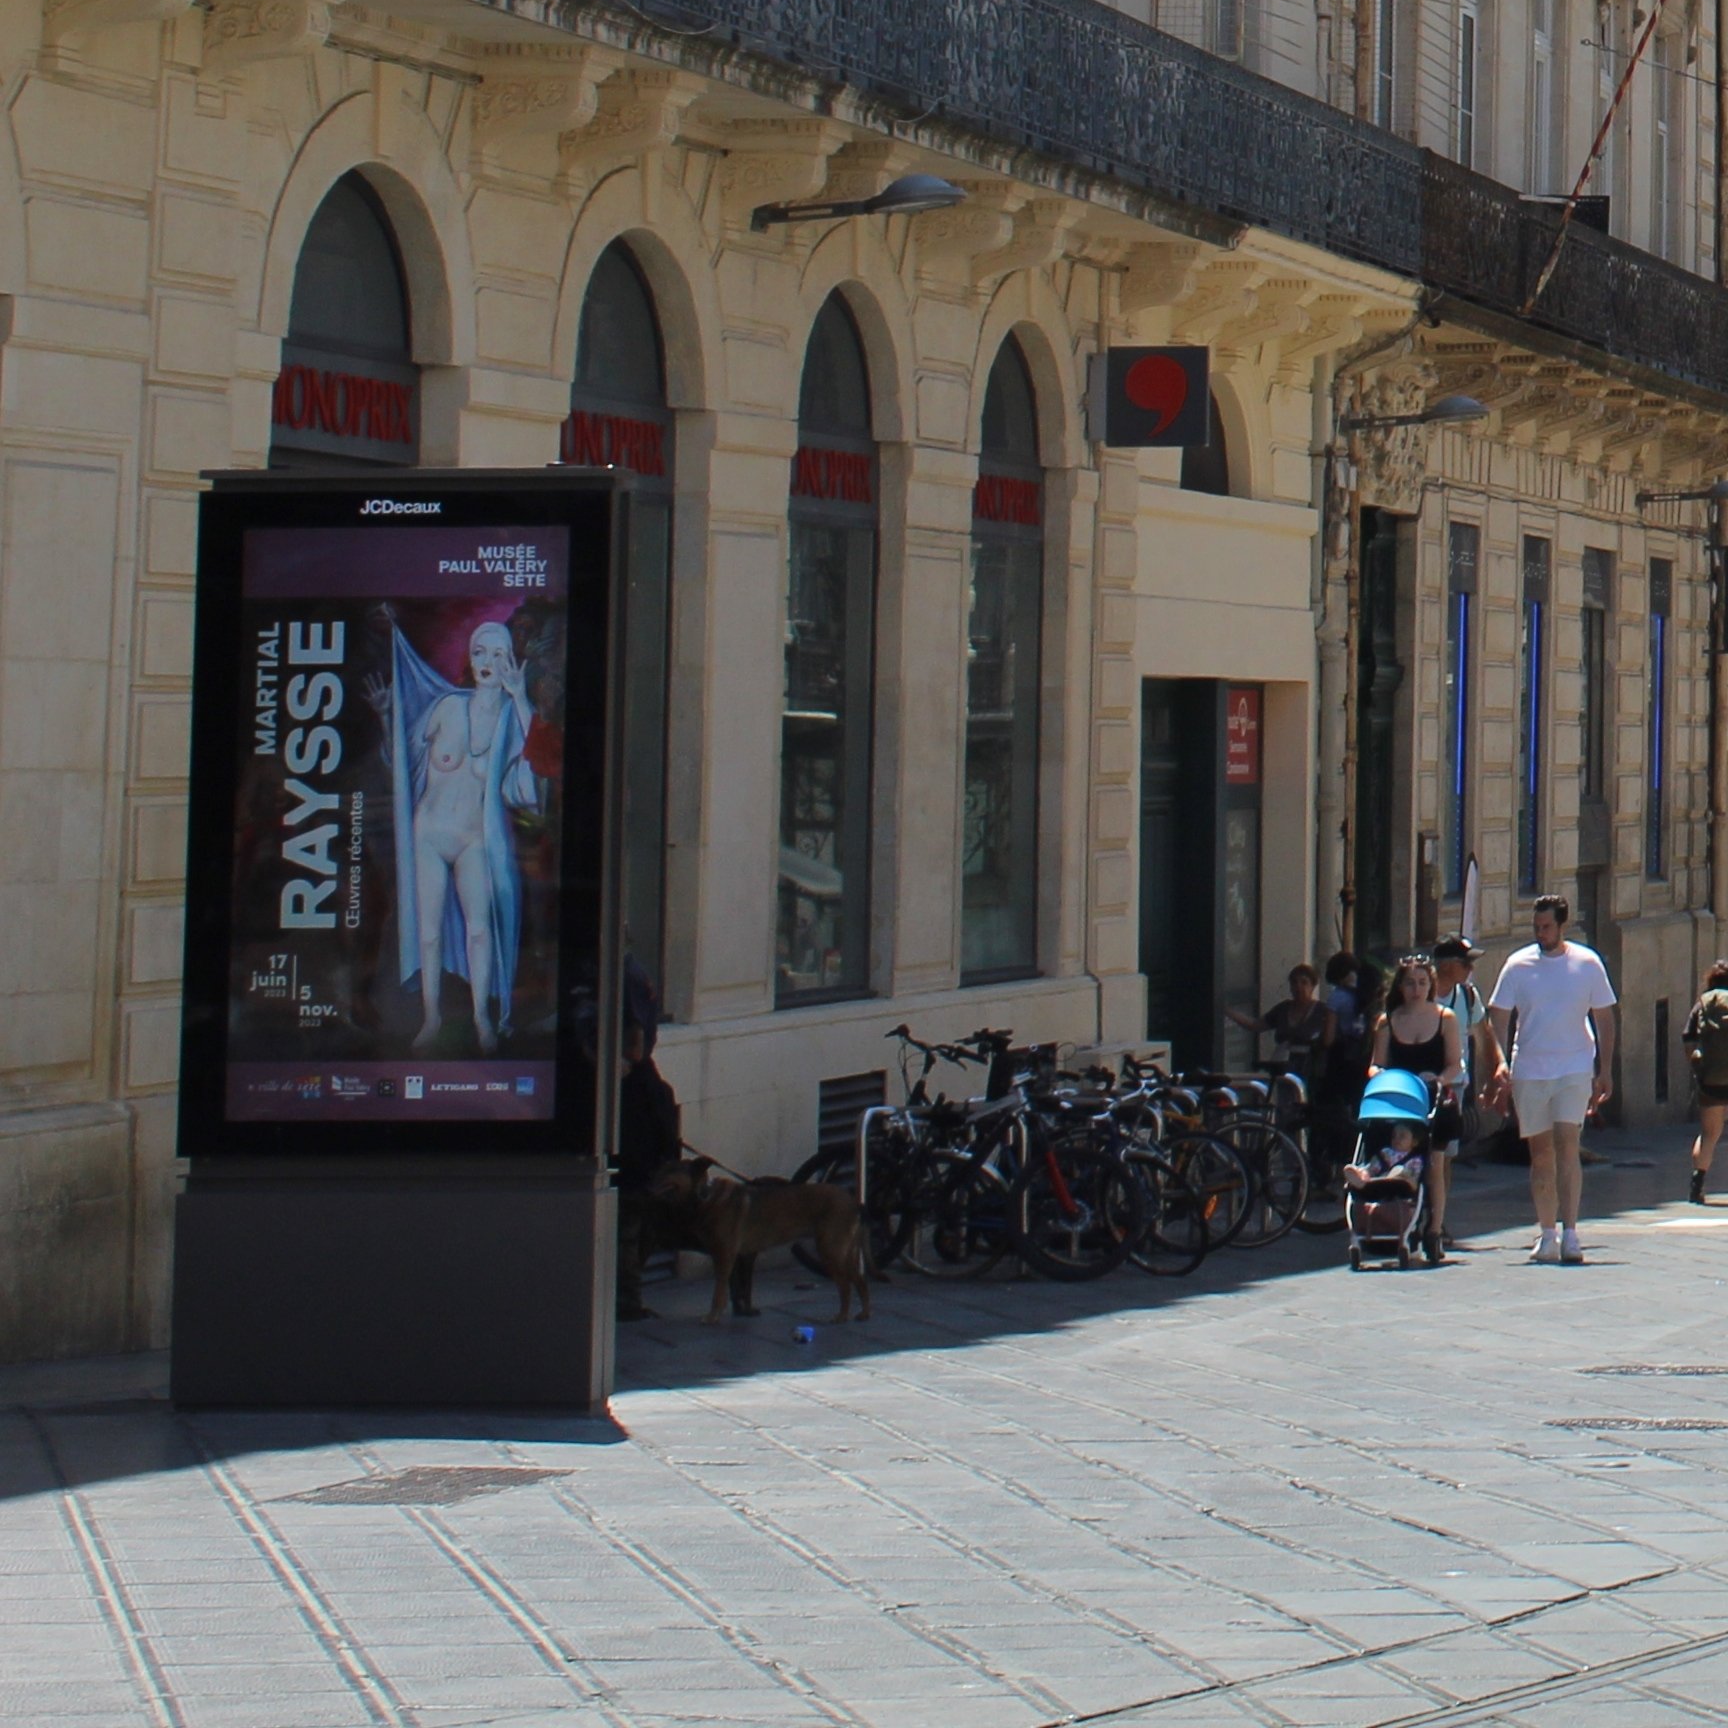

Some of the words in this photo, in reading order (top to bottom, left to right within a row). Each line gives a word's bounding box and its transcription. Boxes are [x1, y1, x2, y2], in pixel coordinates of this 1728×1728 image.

[359, 499, 441, 515] JCDecaux
[477, 543, 536, 560] MUSÉE
[438, 559, 481, 574] PAUL
[483, 557, 548, 574] VALÉRY
[253, 621, 280, 756] MARTIAL
[279, 620, 346, 930] RAYSSE
[346, 790, 364, 863] récentes
[345, 865, 362, 929] Œuvres
[268, 954, 288, 969] 17
[249, 970, 287, 992] juin
[299, 984, 313, 1001] 5
[299, 1004, 339, 1017] nov.
